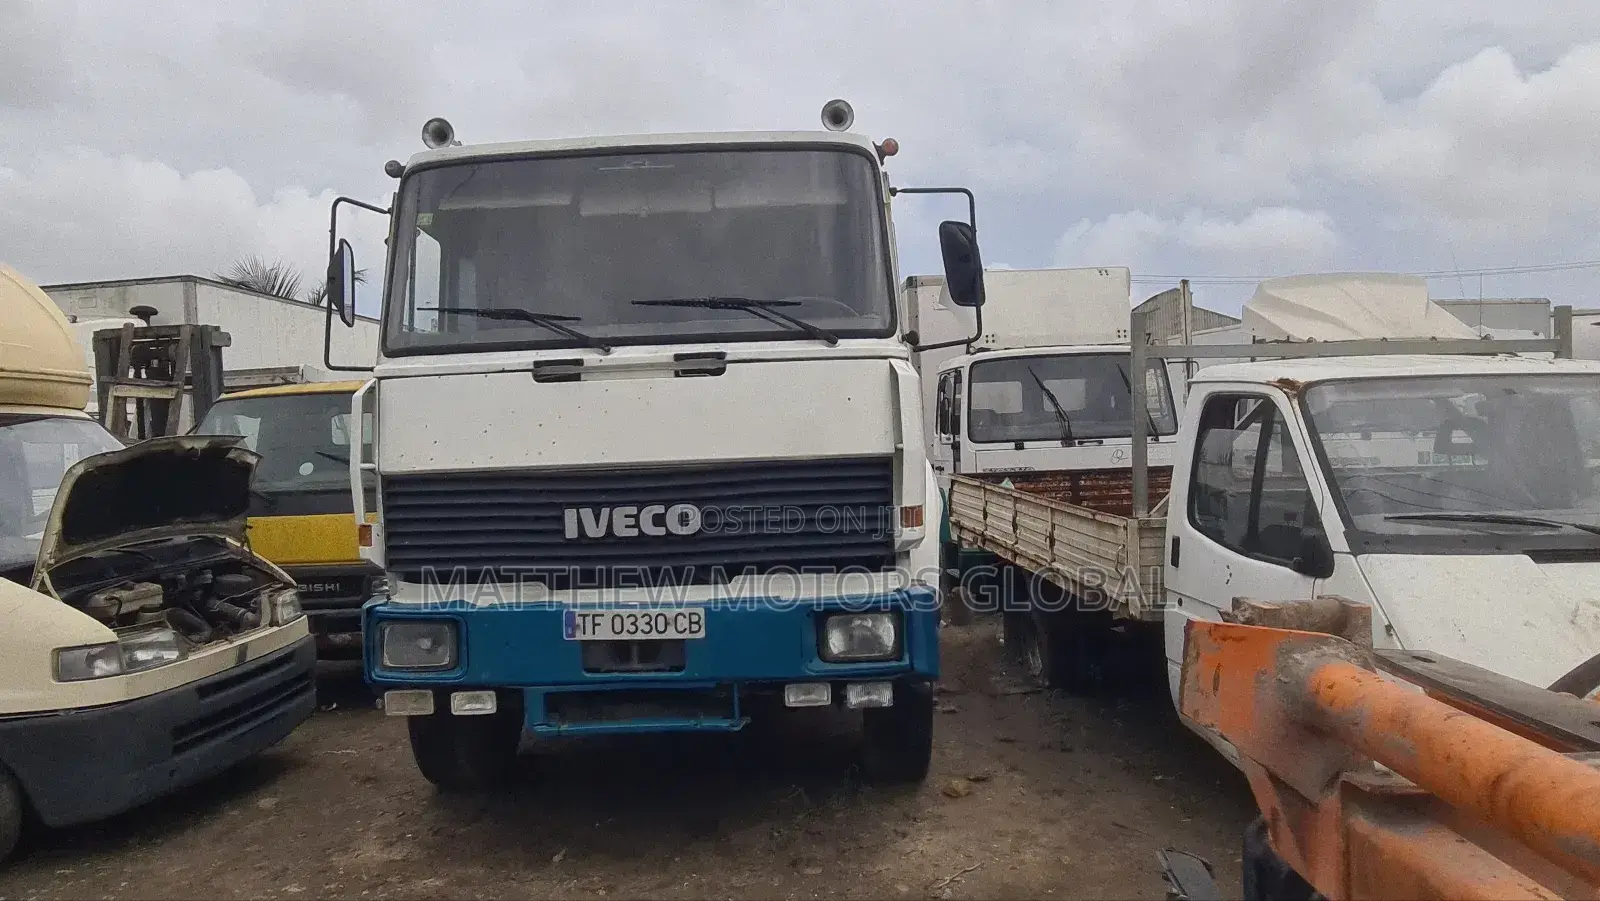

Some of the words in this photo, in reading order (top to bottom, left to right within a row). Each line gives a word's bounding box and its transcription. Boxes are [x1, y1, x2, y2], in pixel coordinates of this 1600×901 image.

[564, 503, 701, 538] IVECO
[577, 613, 605, 636] TF
[611, 612, 668, 635] 0330
[674, 612, 702, 635] CB
